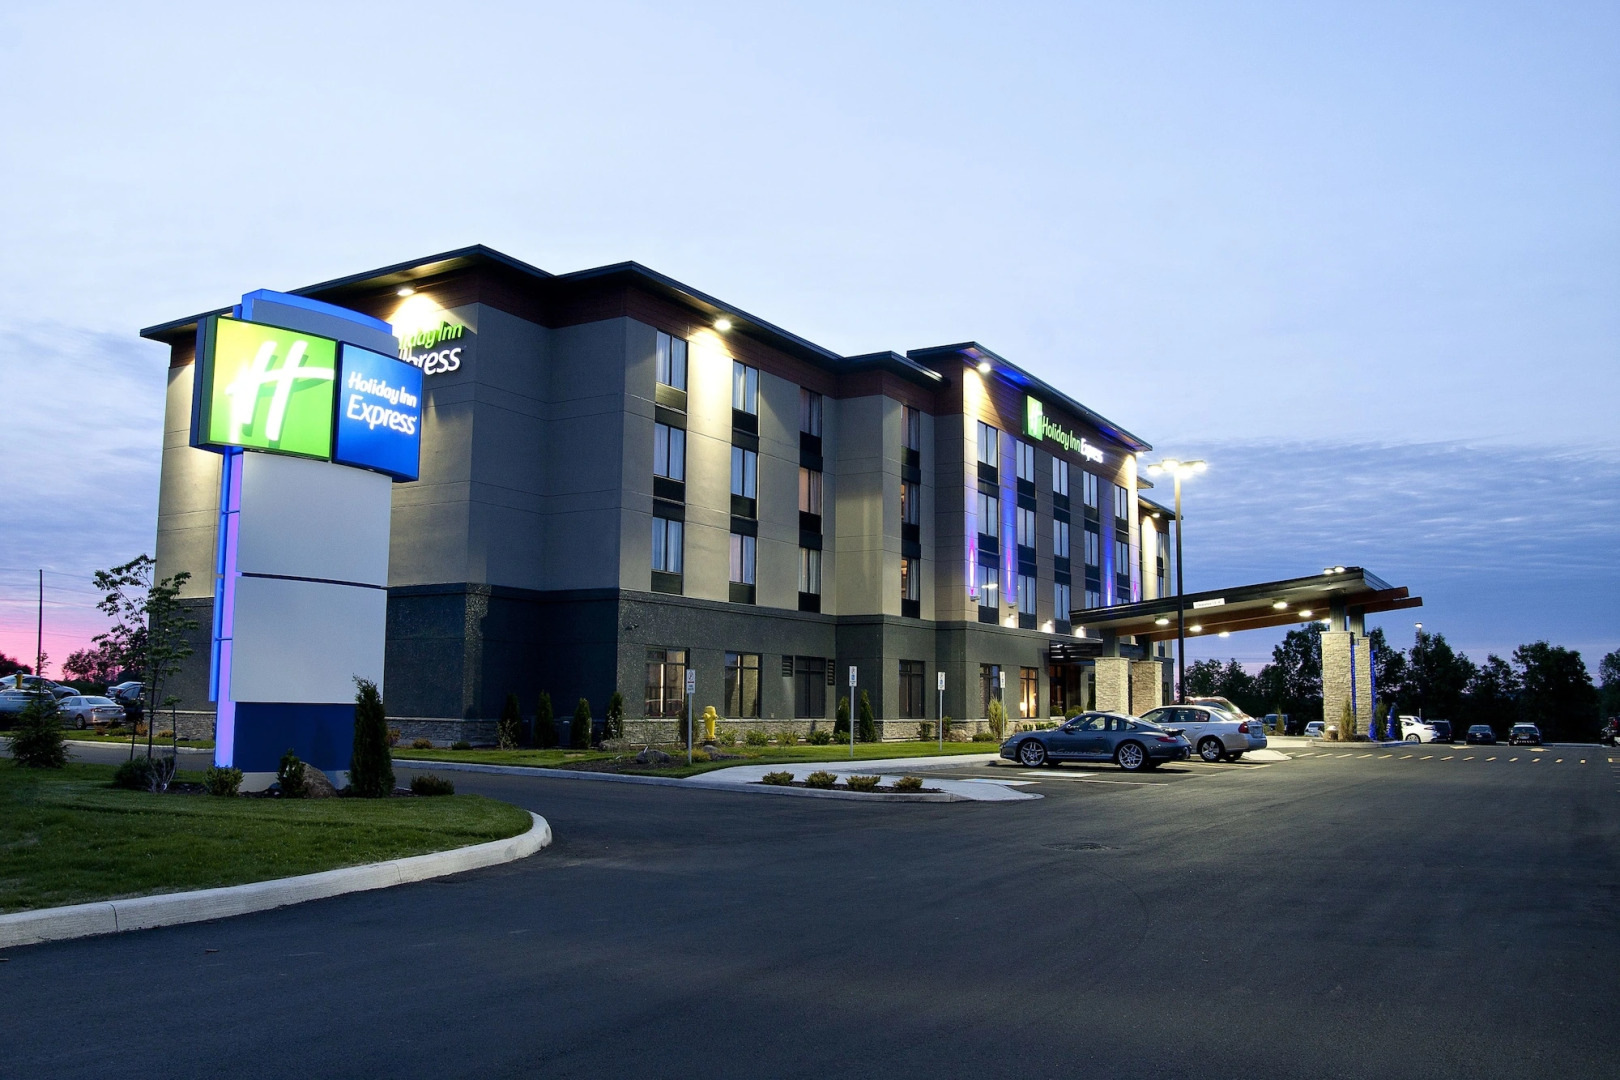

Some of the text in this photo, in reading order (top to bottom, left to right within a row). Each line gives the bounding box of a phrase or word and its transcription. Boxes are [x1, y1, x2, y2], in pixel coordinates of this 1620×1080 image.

[438, 321, 463, 341] Inn
[225, 340, 335, 442] H
[348, 371, 417, 408] Holiday Inn
[346, 394, 415, 435] Express
[1042, 416, 1070, 451] Holiday
[1070, 430, 1081, 452] Inn
